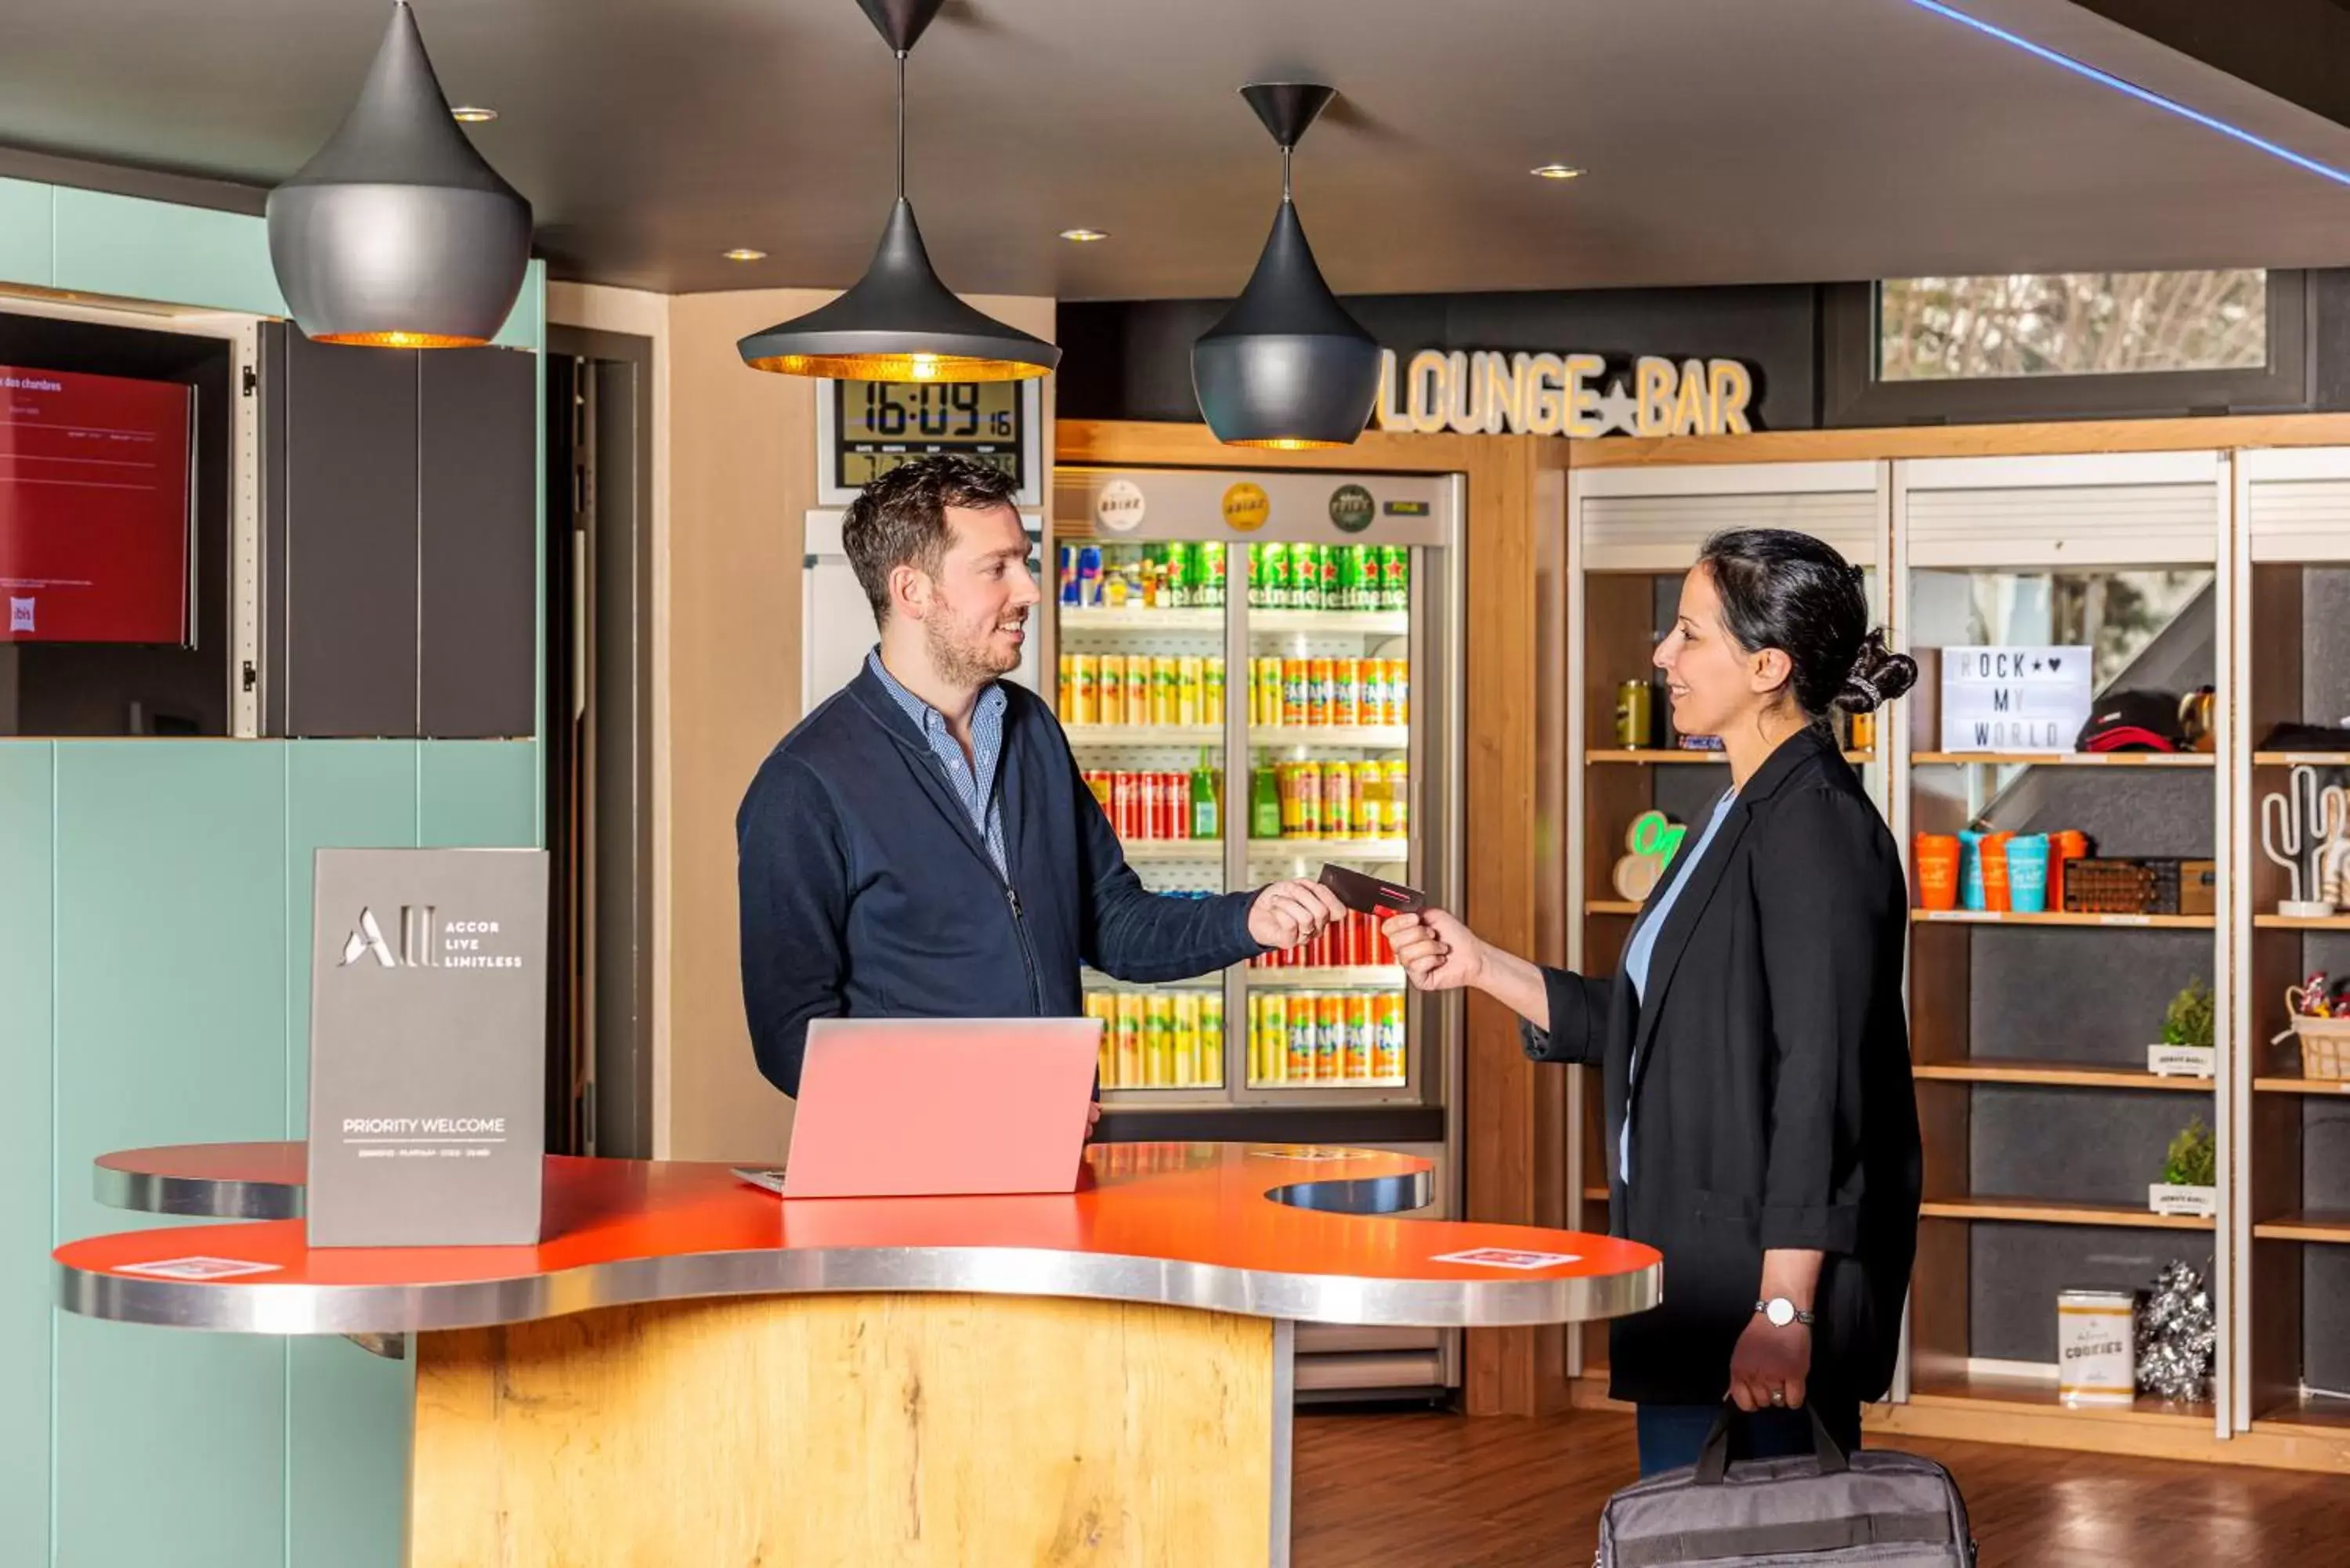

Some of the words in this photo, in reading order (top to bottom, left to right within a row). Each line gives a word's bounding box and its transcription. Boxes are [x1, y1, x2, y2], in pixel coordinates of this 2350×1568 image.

[21, 378, 62, 392] chambres
[1376, 349, 1606, 438] LOUNGE
[1636, 356, 1752, 437] BAR
[866, 381, 978, 435] 16:09
[991, 410, 1011, 436] 16
[1961, 652, 2025, 678] ROCK
[1994, 688, 2024, 713] MY
[1975, 721, 2058, 747] WORLD
[444, 921, 500, 934] ACCOR
[445, 939, 479, 951] LIVE
[444, 956, 522, 968] LIMITLESS
[342, 1118, 419, 1133] PRIORITY
[421, 1118, 505, 1133] WELCOME
